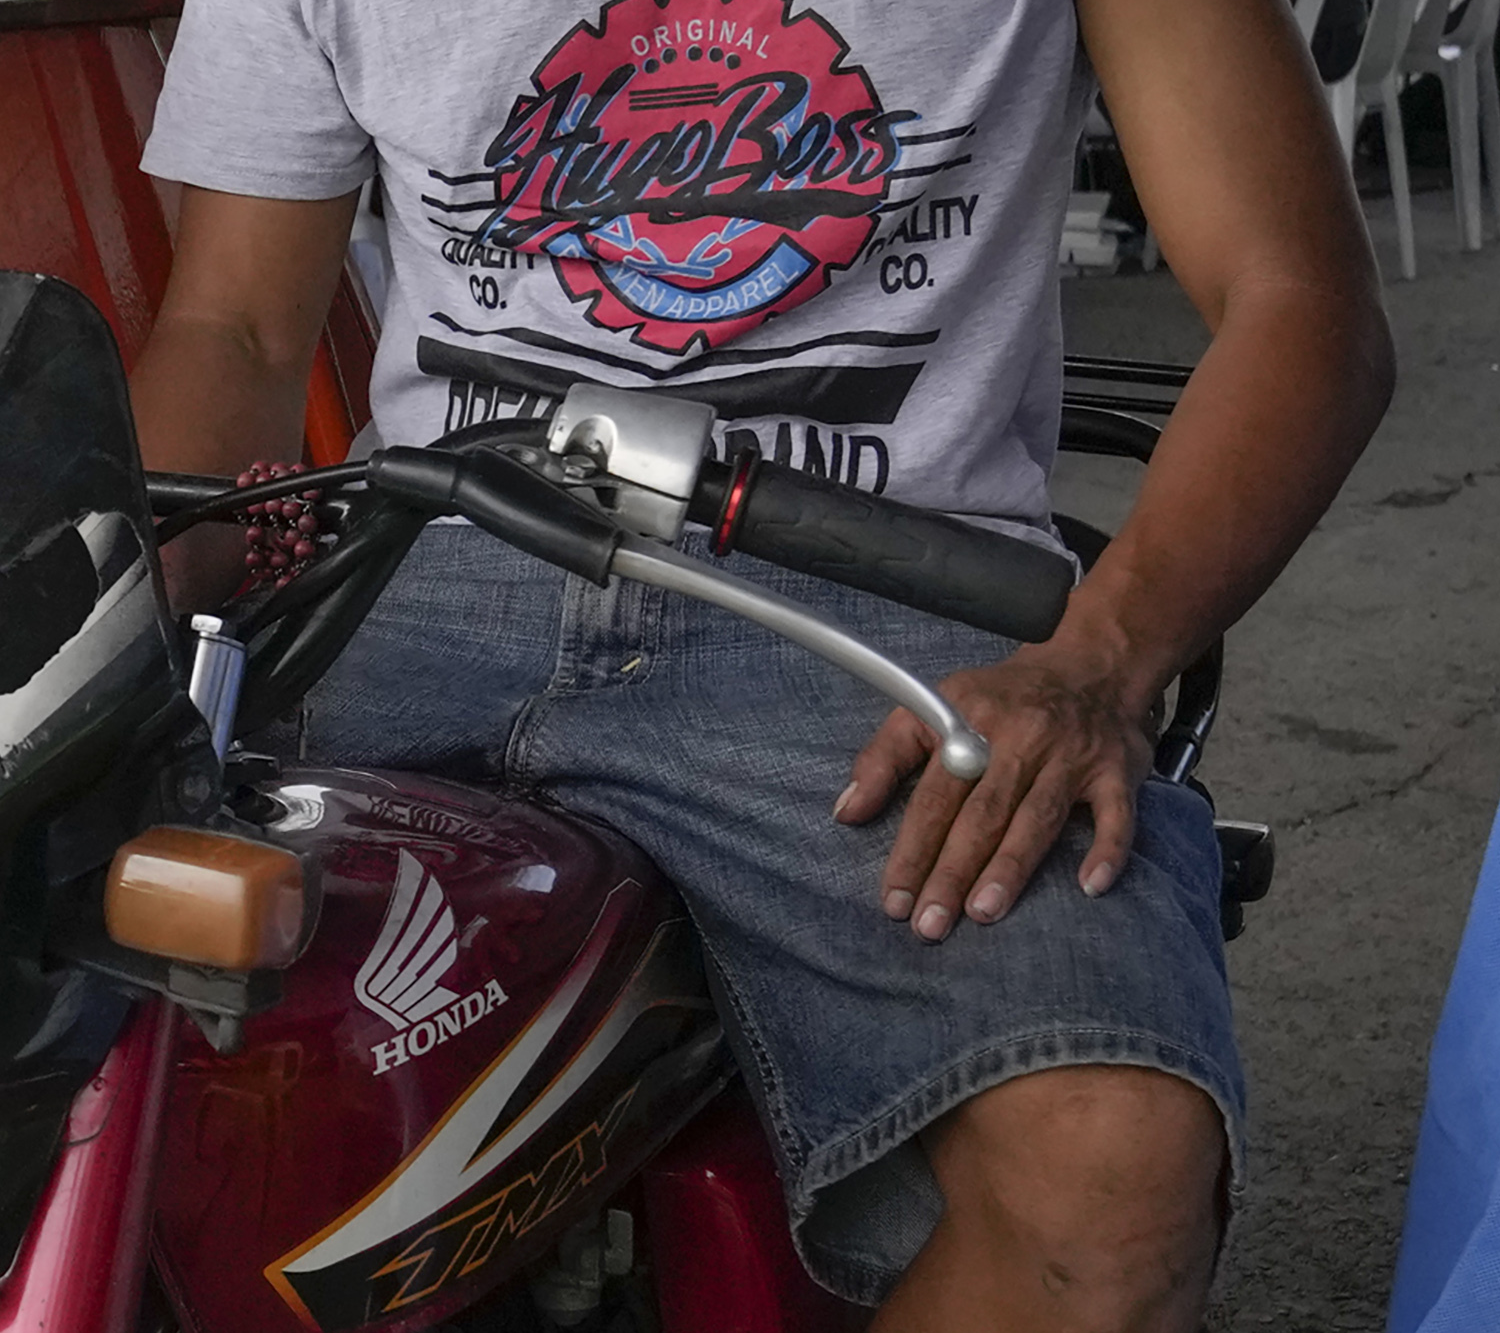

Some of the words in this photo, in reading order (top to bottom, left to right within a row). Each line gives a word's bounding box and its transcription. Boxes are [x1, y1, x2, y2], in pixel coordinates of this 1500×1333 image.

[630, 18, 771, 60] ORIGINAL
[469, 274, 508, 310] CO.
[662, 263, 800, 319] APPAREL
[880, 253, 935, 295] CO.
[370, 977, 510, 1076] HONDA
